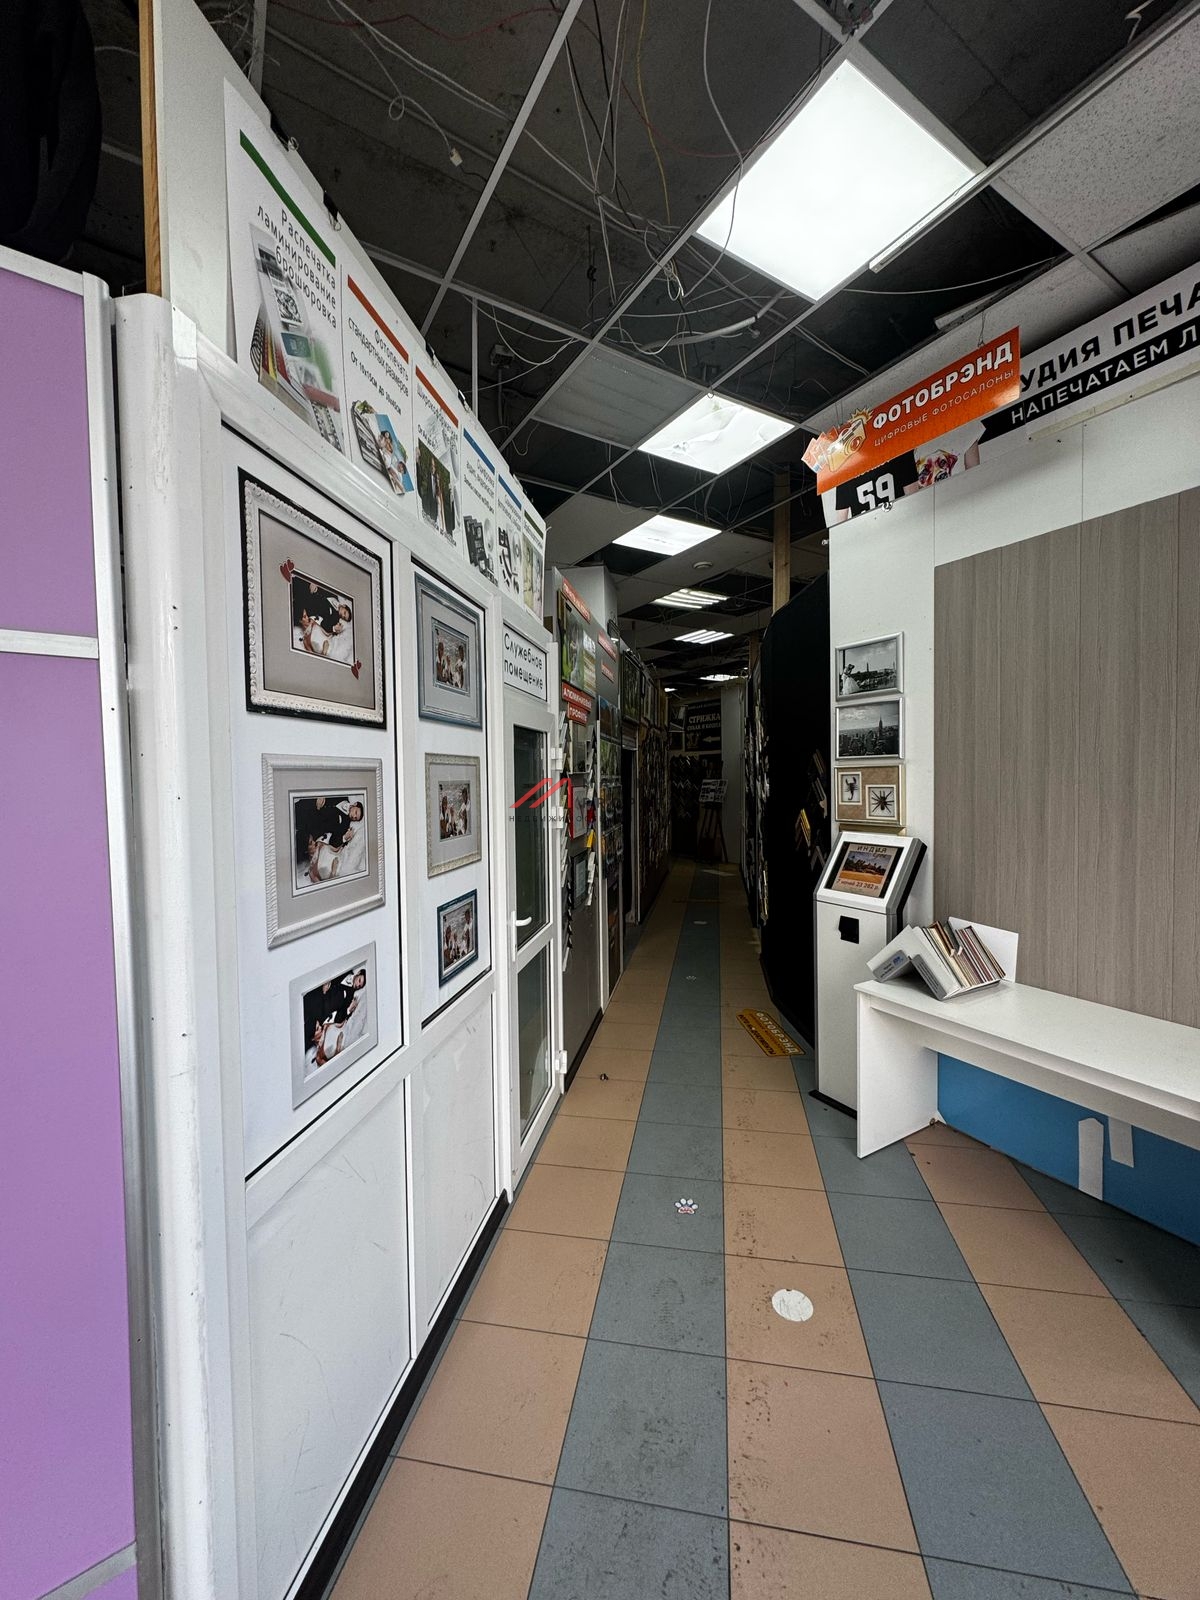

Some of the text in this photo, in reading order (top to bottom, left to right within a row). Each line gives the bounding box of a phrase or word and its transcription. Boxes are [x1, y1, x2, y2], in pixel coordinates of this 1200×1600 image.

[257, 205, 336, 310] ламинирование
[276, 245, 337, 328] брошюровка
[281, 208, 336, 290] Распечатка
[348, 317, 409, 397] стандартных размеров
[374, 329, 409, 381] Фотопечать
[872, 340, 1013, 430] ФОТОБРЭНД
[1011, 338, 1169, 425] НАПЕЧАТАЕМ
[874, 369, 1014, 447] ЦИФРОВЫЕ ФОТОСАЛОНЫ
[504, 633, 542, 670] Служебное
[504, 659, 543, 690] помещение
[688, 713, 720, 724] СТРИЖКА
[857, 845, 887, 854] ИНДИЯ
[756, 1011, 800, 1054] ФОТОБРЭНД
